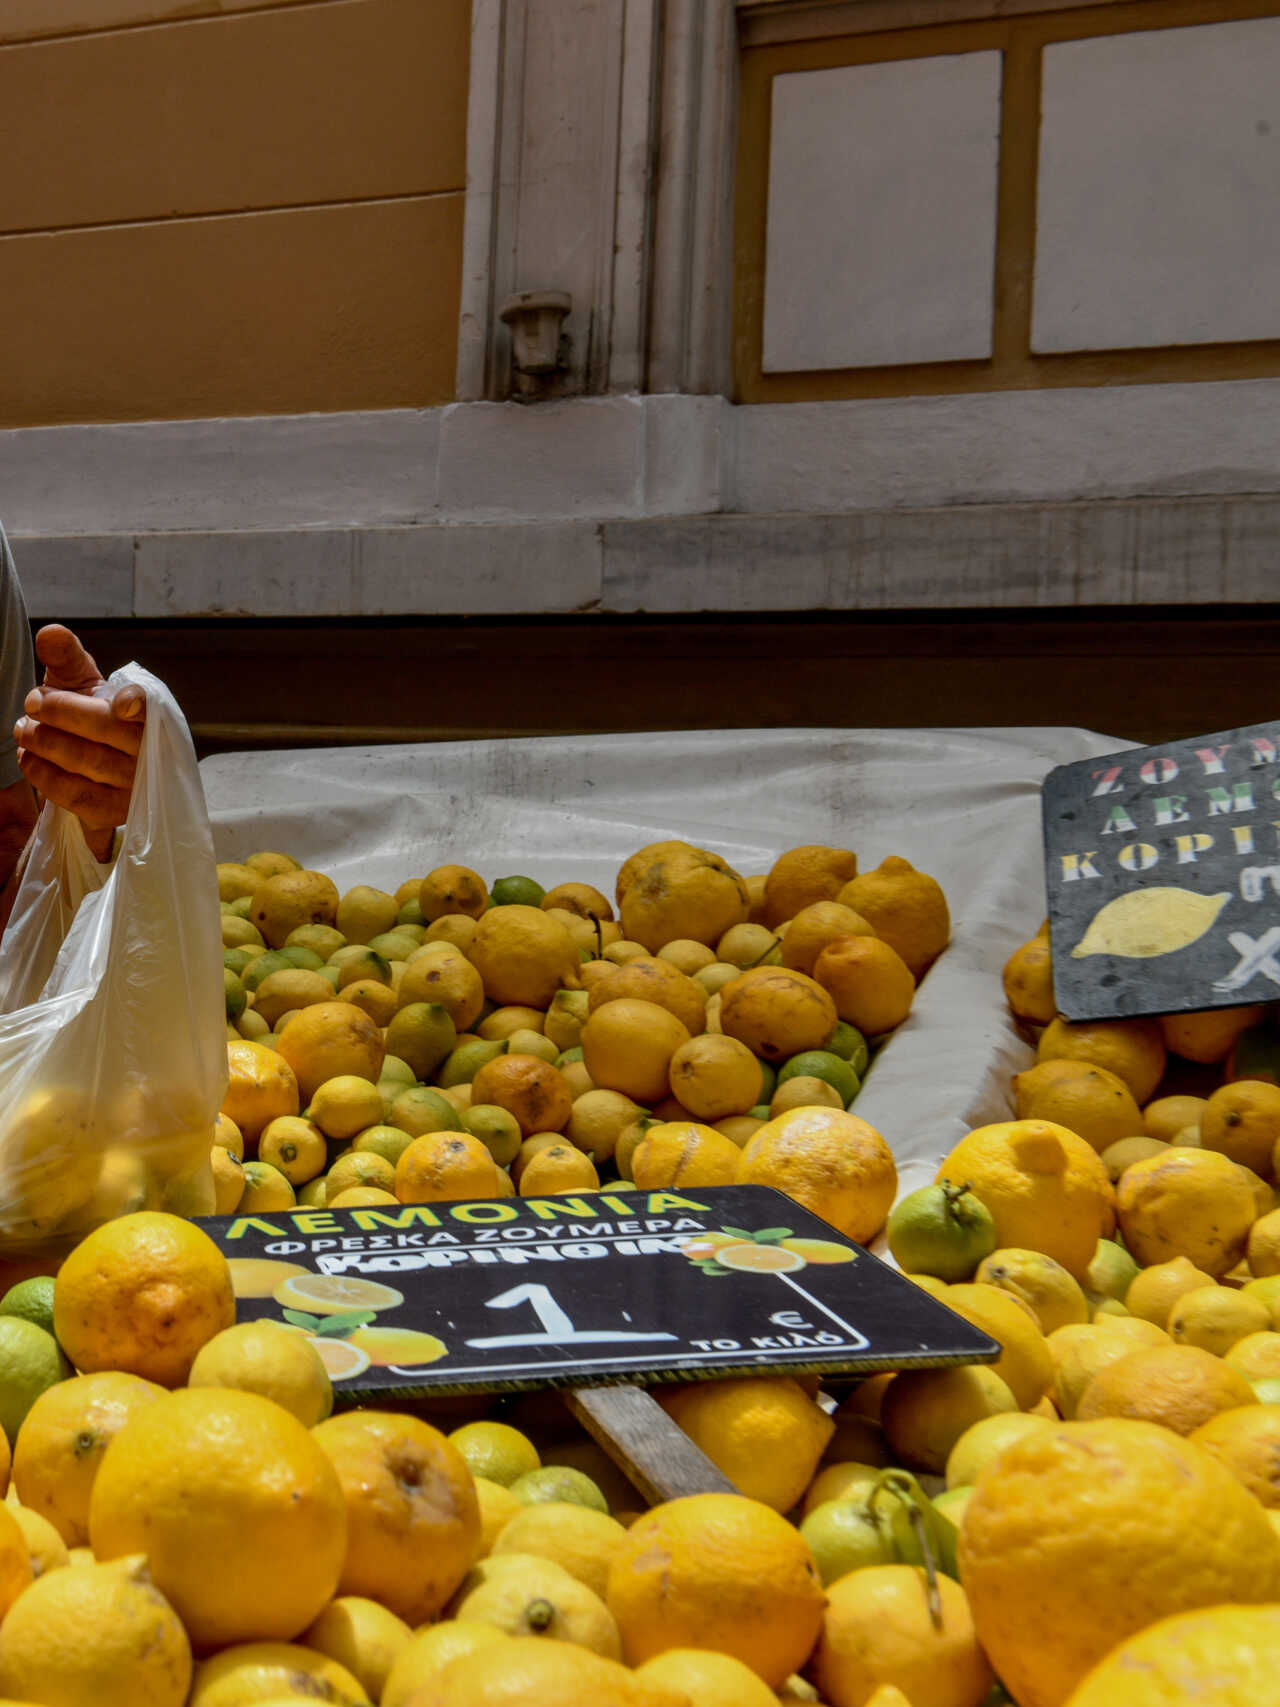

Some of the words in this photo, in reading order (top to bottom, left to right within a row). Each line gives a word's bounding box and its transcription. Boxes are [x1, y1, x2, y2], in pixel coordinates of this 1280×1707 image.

[225, 1193, 712, 1239] ΛΕΜΟΝΙΑ
[473, 1217, 707, 1242] ΖΟΥΜΕΡΑ
[464, 1283, 679, 1349] 1
